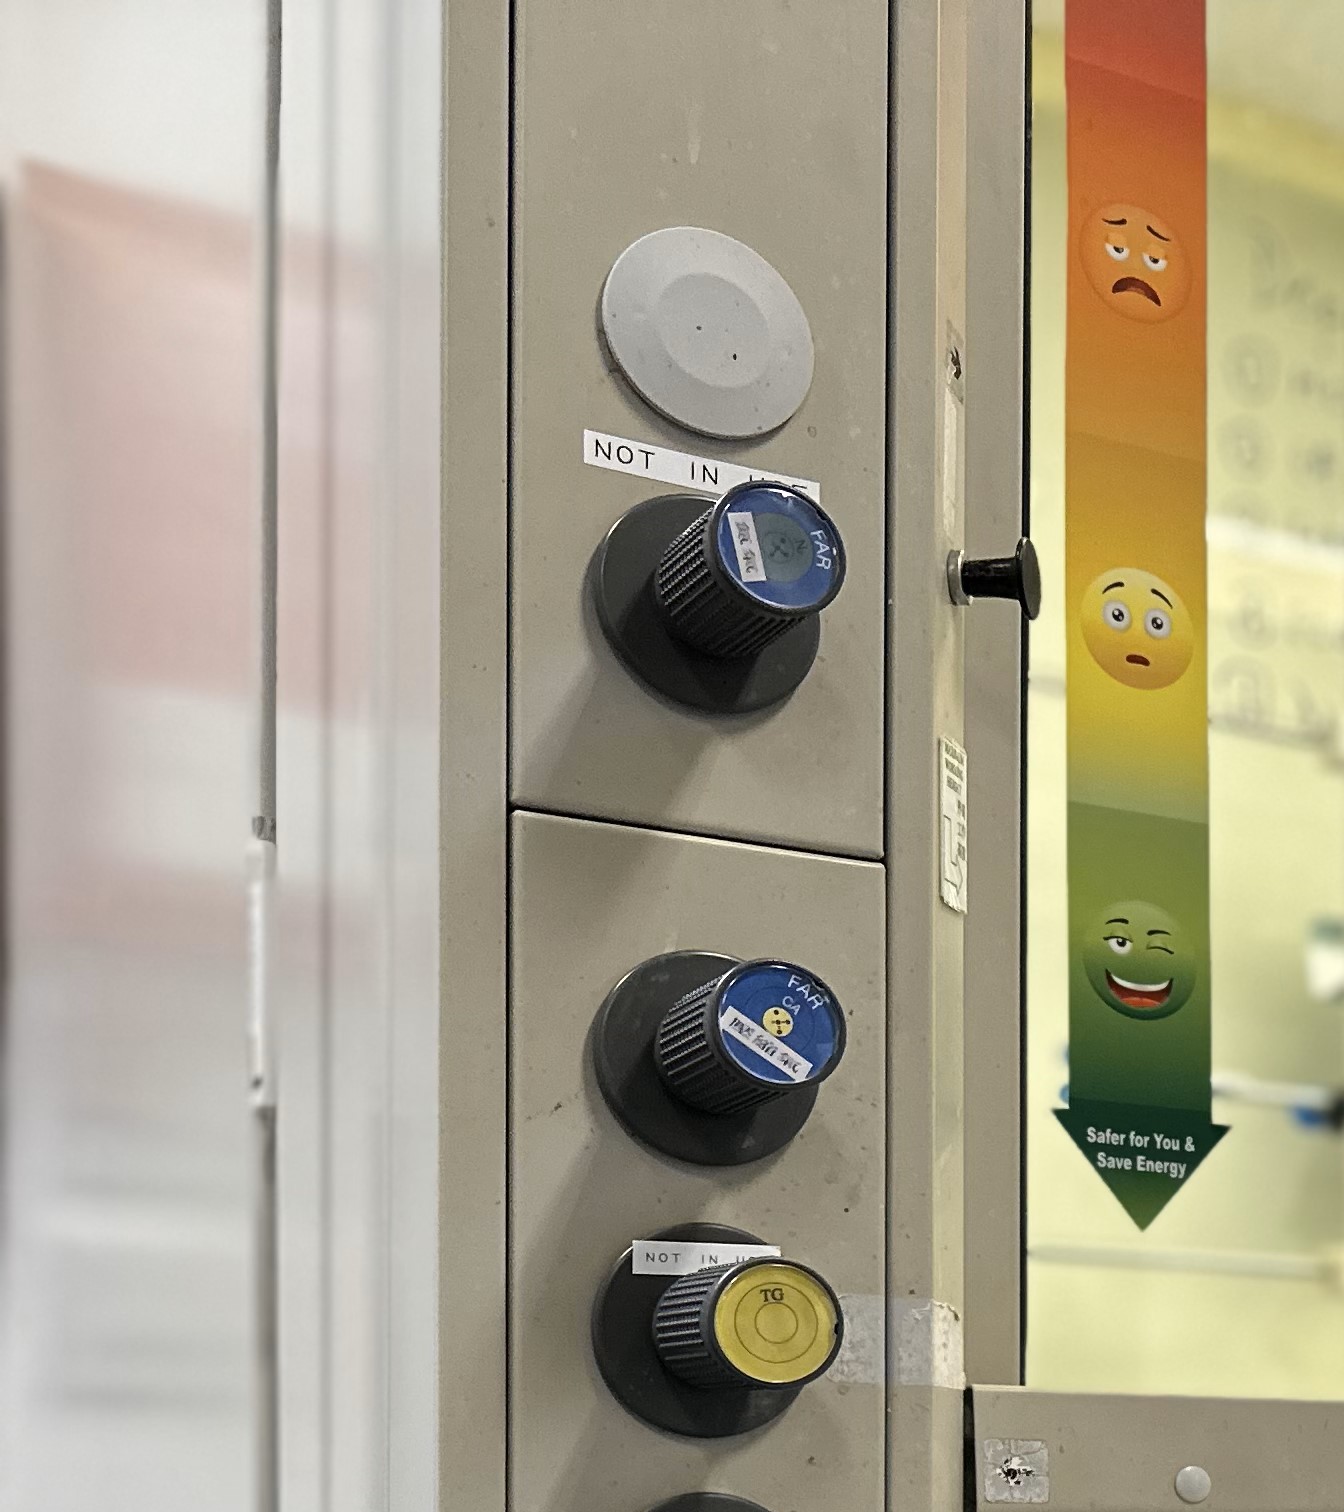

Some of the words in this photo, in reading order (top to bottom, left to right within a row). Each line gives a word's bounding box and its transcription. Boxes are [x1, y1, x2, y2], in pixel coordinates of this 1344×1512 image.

[594, 438, 656, 470] NOT
[690, 461, 719, 486] IN
[810, 529, 832, 570] FAR
[787, 974, 825, 1010] FAR
[1086, 1126, 1126, 1147] Safer
[1129, 1130, 1150, 1148] for
[1153, 1133, 1180, 1152] You
[1184, 1136, 1196, 1152] &
[1096, 1152, 1133, 1171] Save
[1136, 1155, 1187, 1179] Energy
[645, 1252, 682, 1264] NOT
[701, 1254, 719, 1265] IN
[760, 1287, 784, 1303] TG
